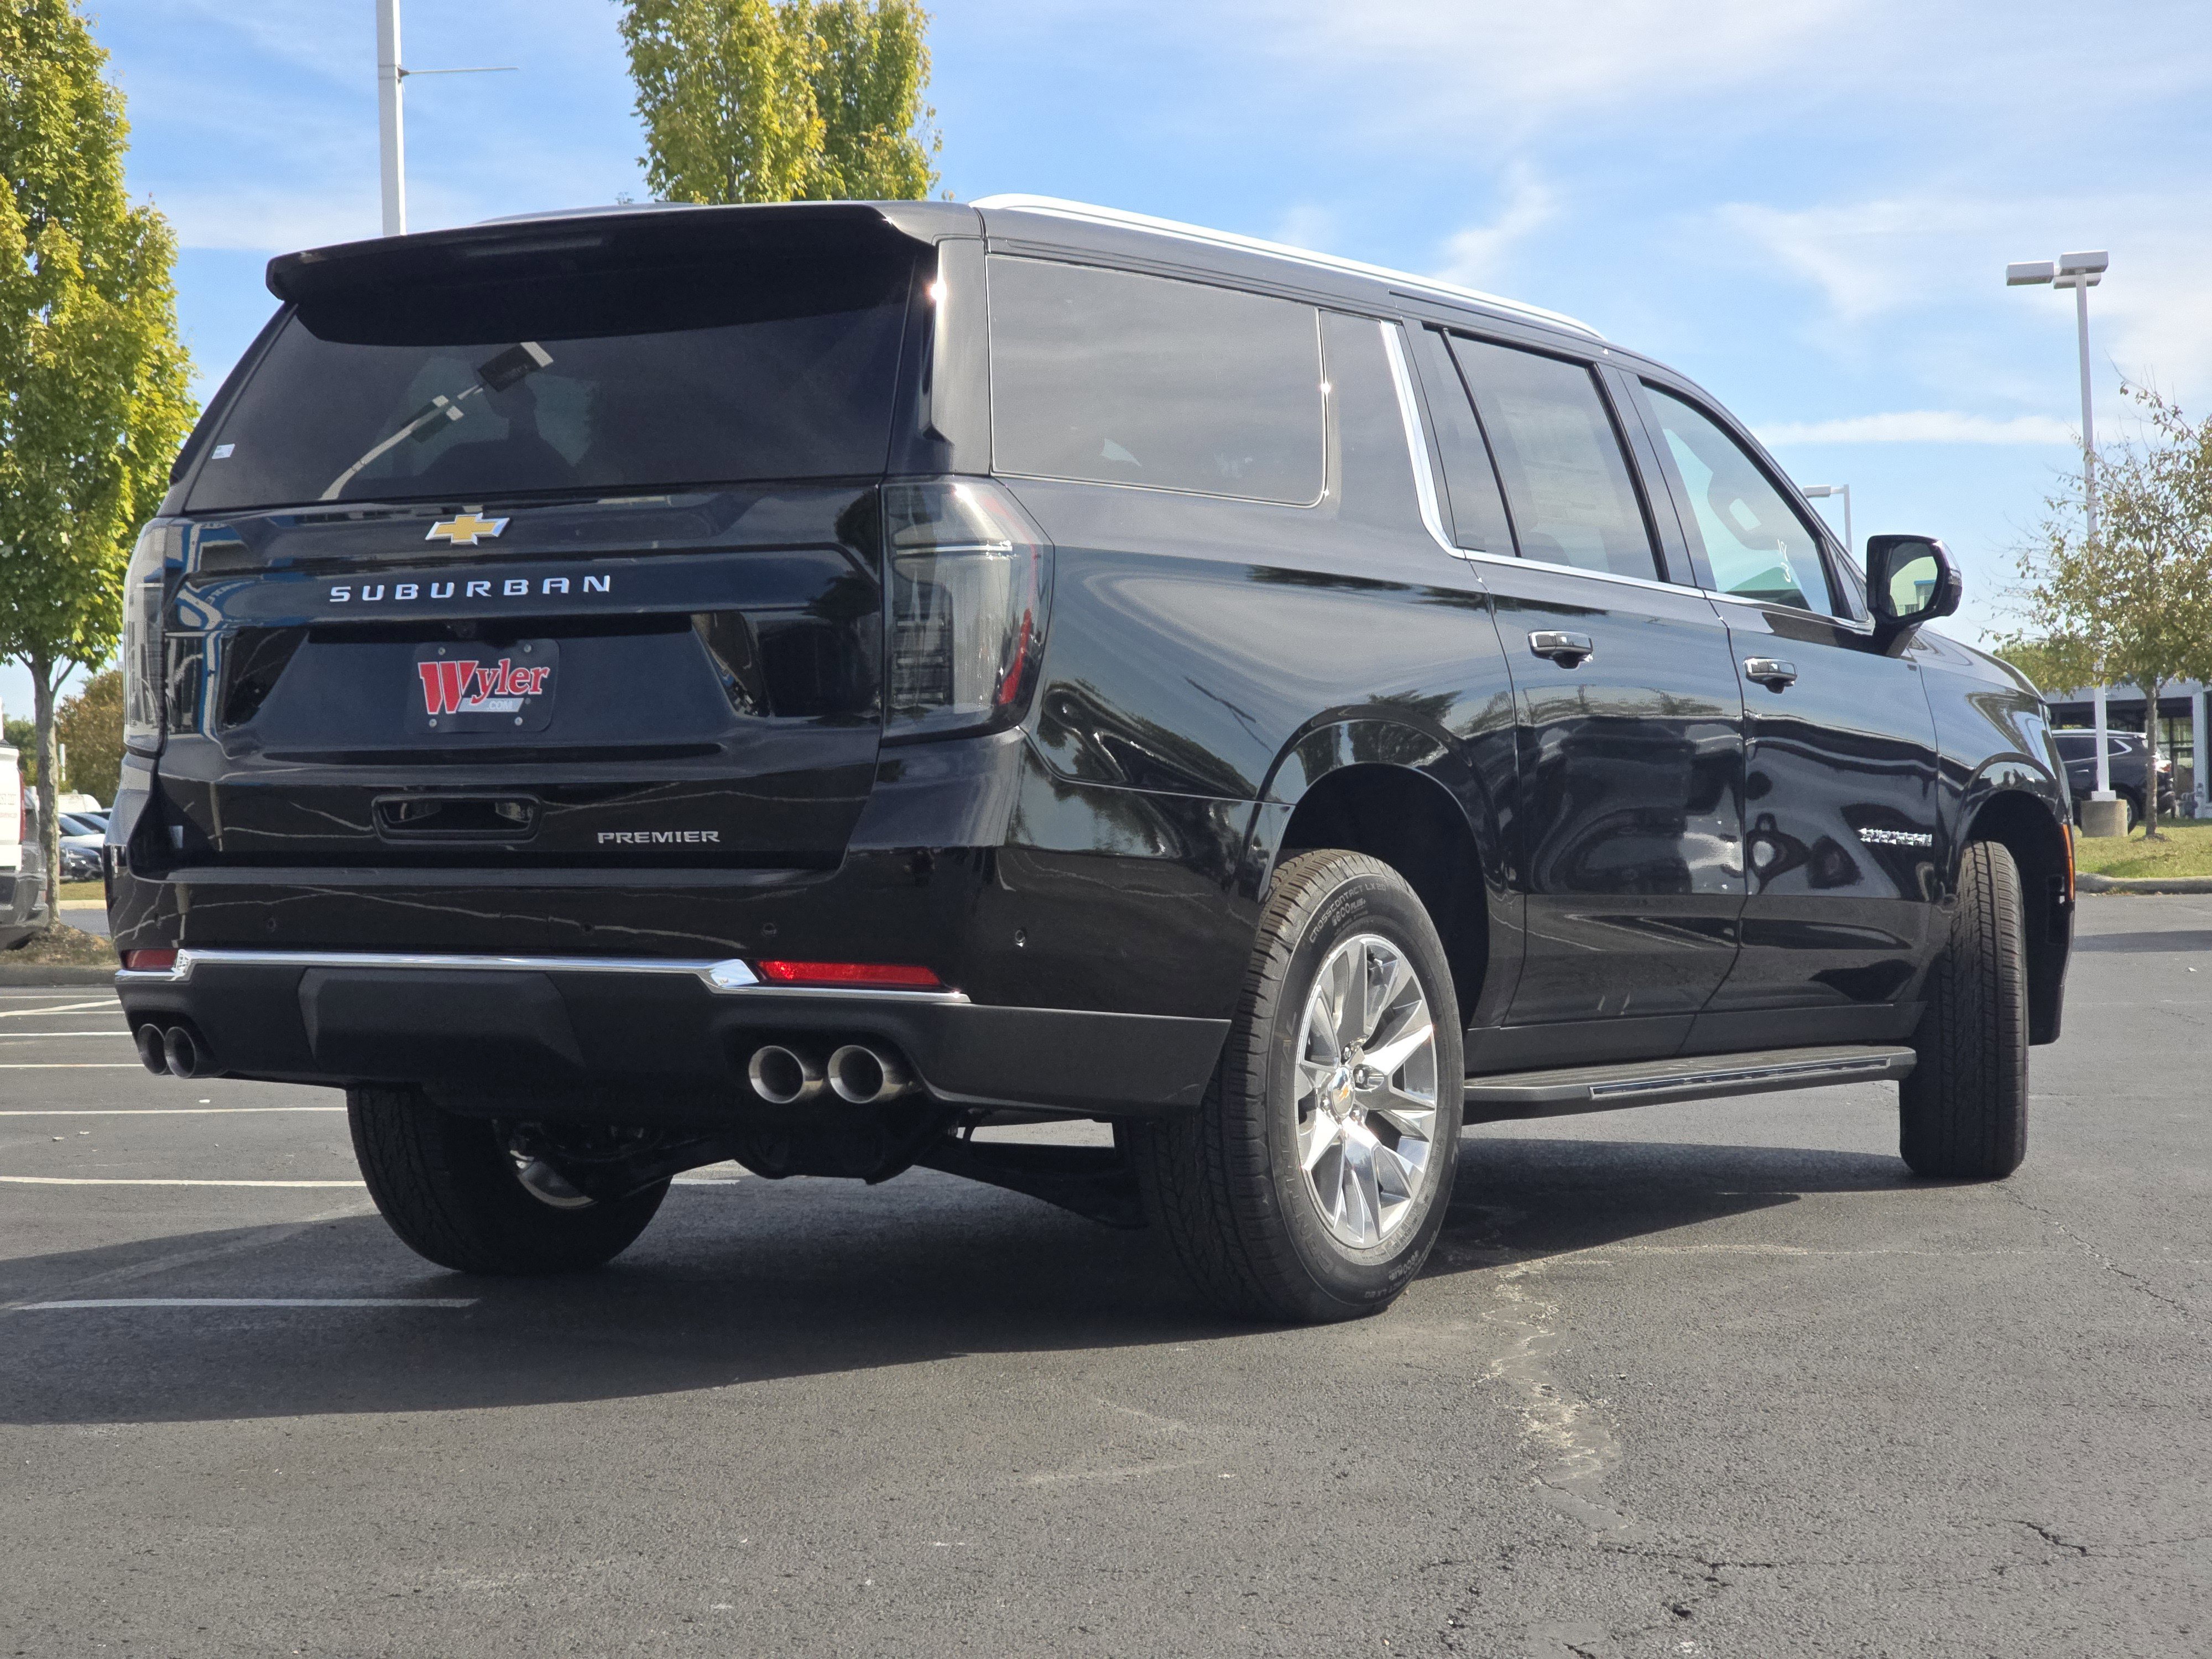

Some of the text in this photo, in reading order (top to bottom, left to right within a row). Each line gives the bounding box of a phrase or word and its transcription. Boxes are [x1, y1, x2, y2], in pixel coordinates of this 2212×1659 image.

[329, 575, 611, 602] SUBURBAN
[418, 658, 550, 714] Wyler
[597, 831, 721, 844] PREMIER
